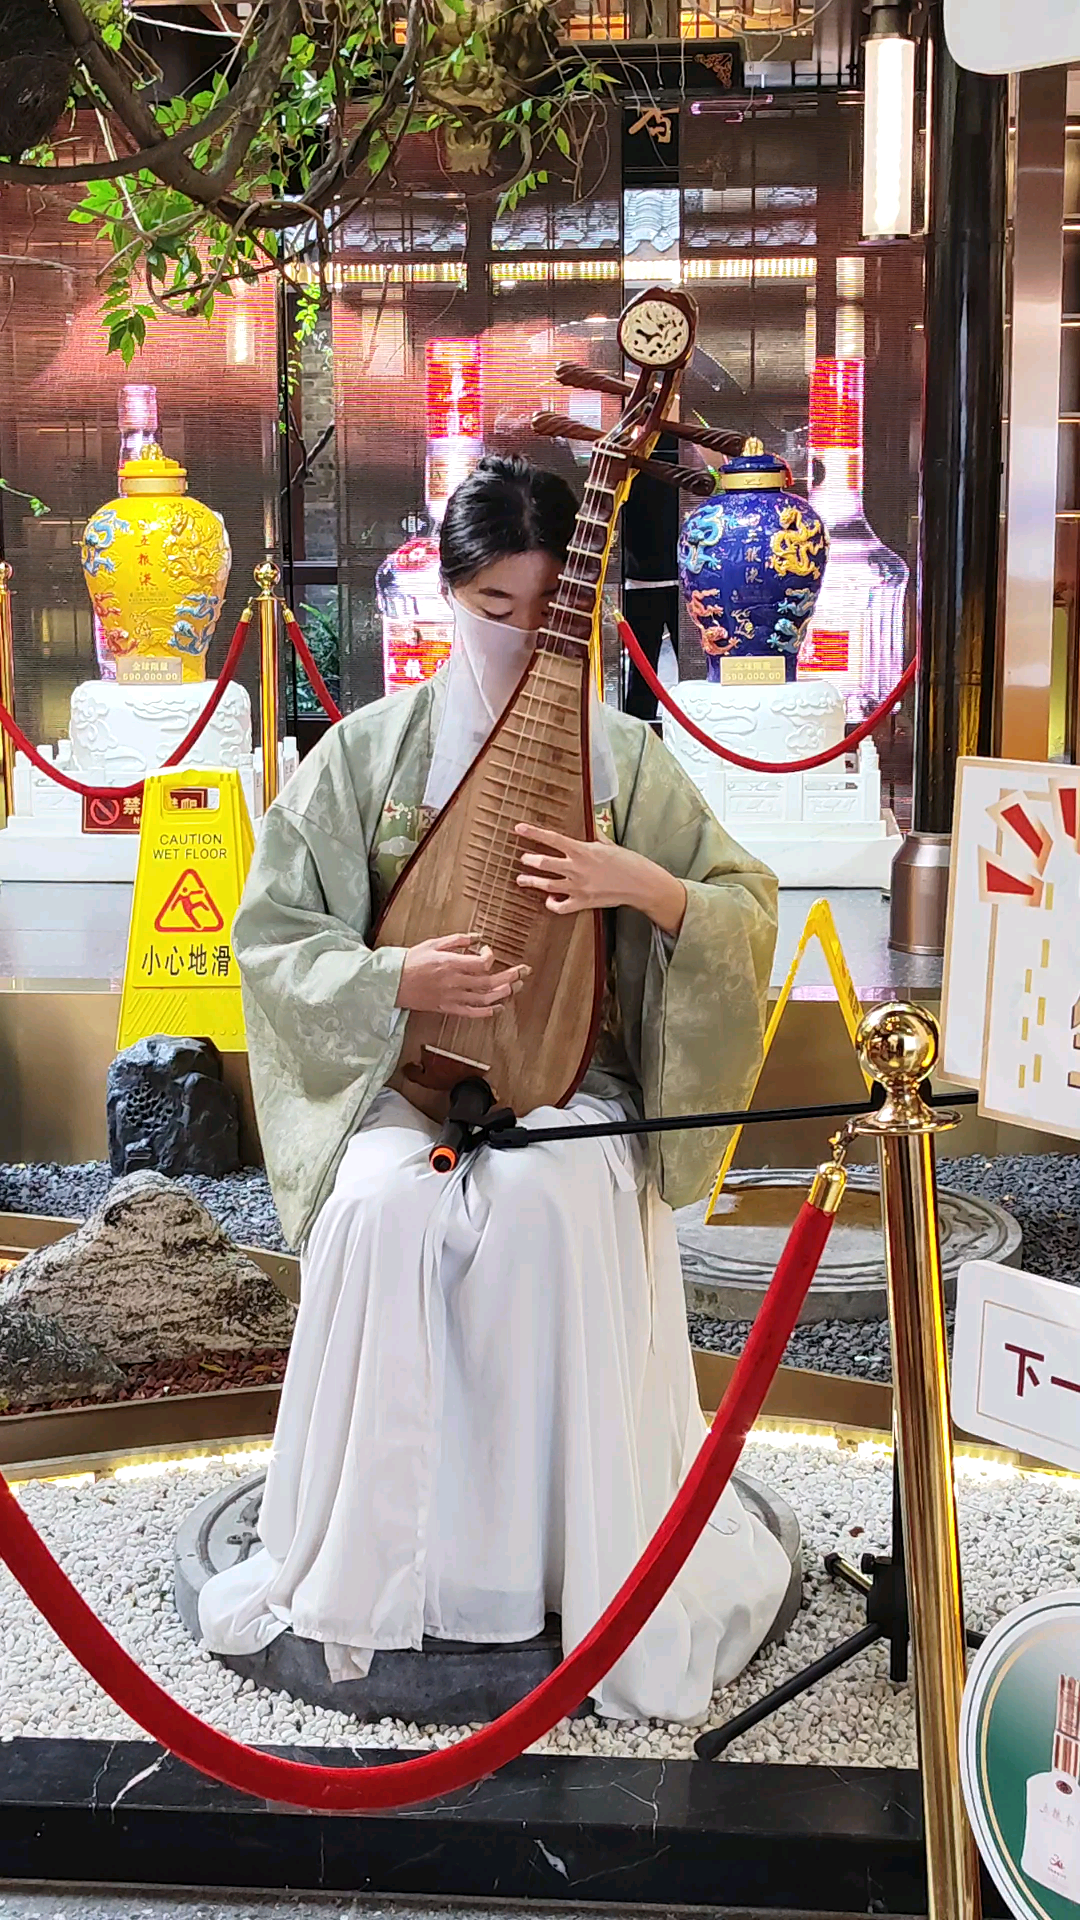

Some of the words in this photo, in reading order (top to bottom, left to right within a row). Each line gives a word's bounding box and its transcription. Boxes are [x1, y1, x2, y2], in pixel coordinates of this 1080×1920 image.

[160, 833, 222, 845] CAUTION
[153, 848, 179, 860] WET
[185, 848, 227, 859] FLOOR
[141, 943, 231, 976] 小心地滑
